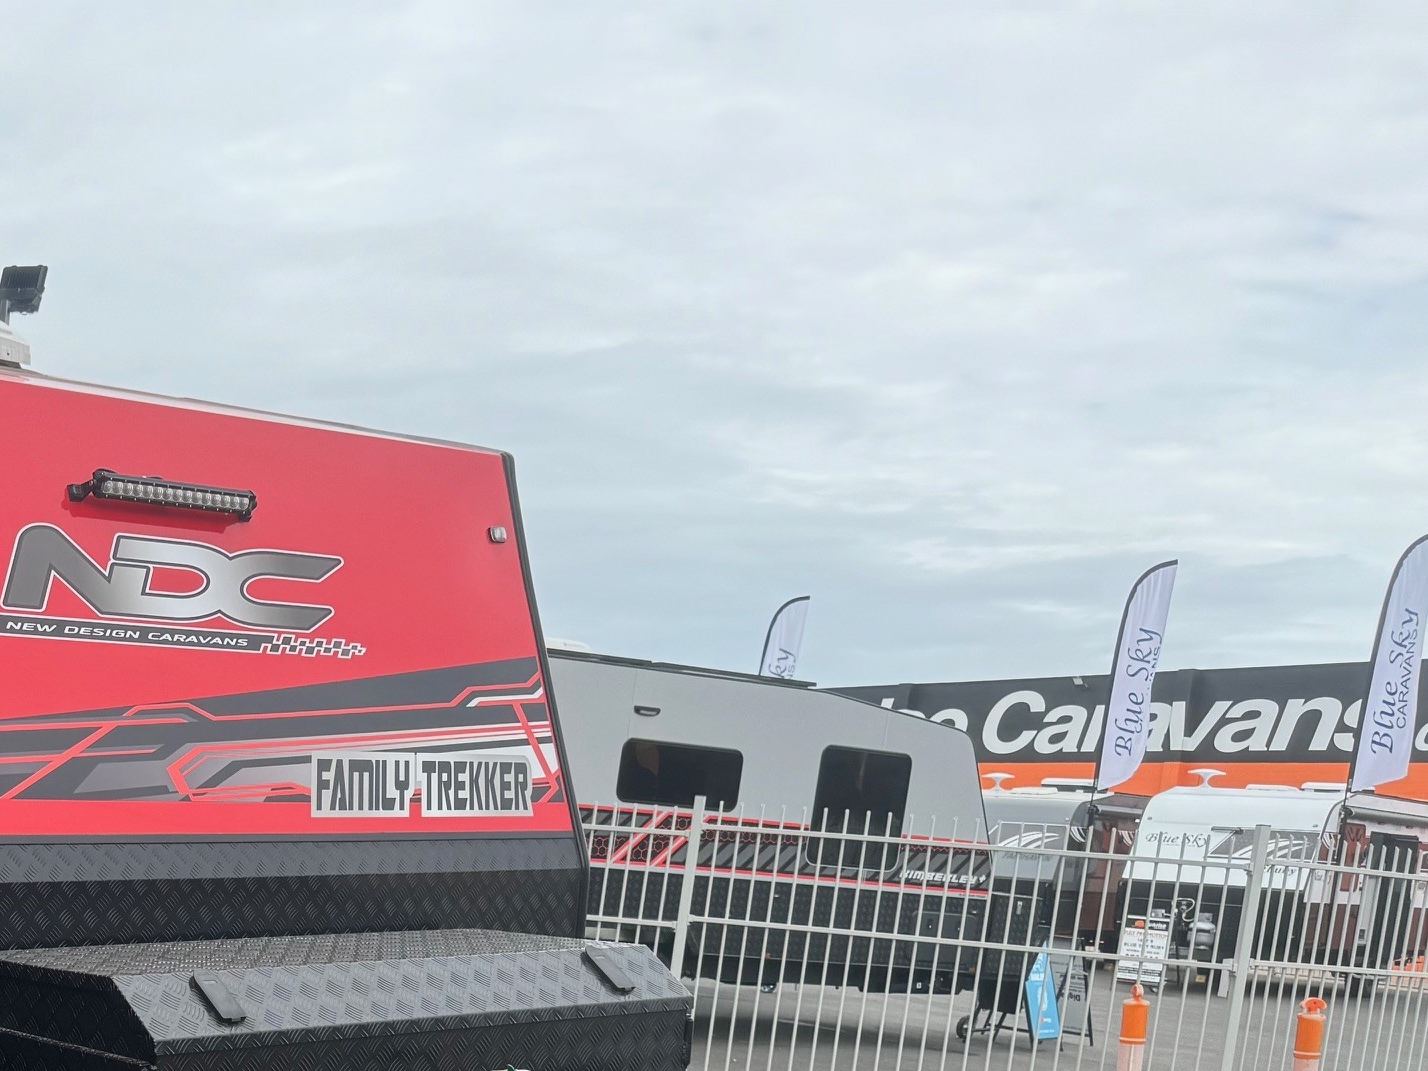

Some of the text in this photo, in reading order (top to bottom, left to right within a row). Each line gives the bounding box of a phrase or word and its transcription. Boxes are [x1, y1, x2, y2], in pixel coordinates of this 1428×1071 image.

[0, 523, 344, 631] NDC
[5, 621, 249, 647] NEW DESIGN CARAVANS
[1126, 627, 1163, 682] Sky
[1370, 607, 1420, 754] Blue Sky
[1395, 628, 1418, 729] CARAVANS
[1114, 692, 1145, 756] Blue
[316, 758, 529, 811] FAMILY TREKKER
